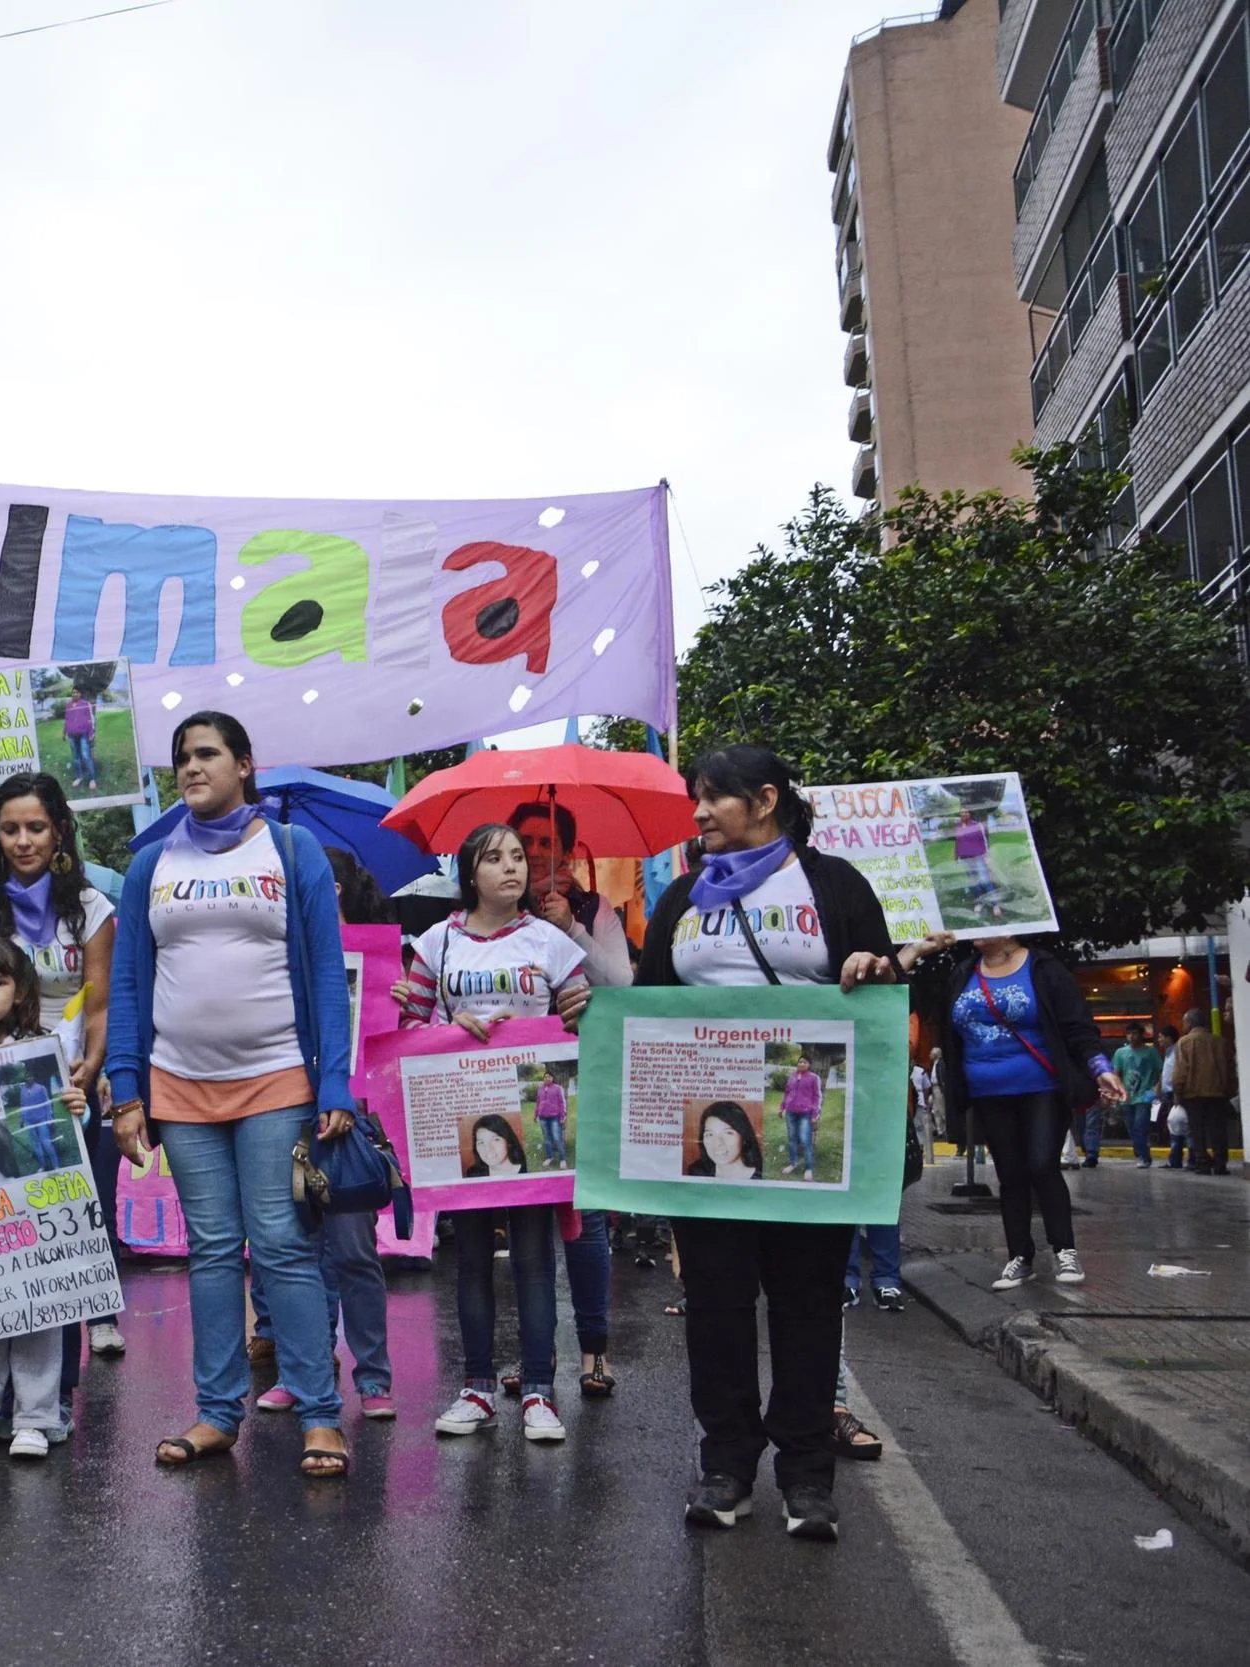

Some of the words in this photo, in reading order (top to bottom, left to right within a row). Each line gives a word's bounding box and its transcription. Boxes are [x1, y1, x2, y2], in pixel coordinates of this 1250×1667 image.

[15, 707, 28, 729] A
[809, 791, 828, 819] E
[866, 820, 923, 848] VEGA
[694, 1025, 791, 1044] Urgente!!!
[458, 1051, 536, 1071] Urgente!!!
[37, 1211, 57, 1241] 5
[59, 1207, 79, 1236] 3
[83, 1200, 105, 1231] 16
[12, 1257, 21, 1273] A
[25, 1237, 109, 1269] ENCONTRARLA
